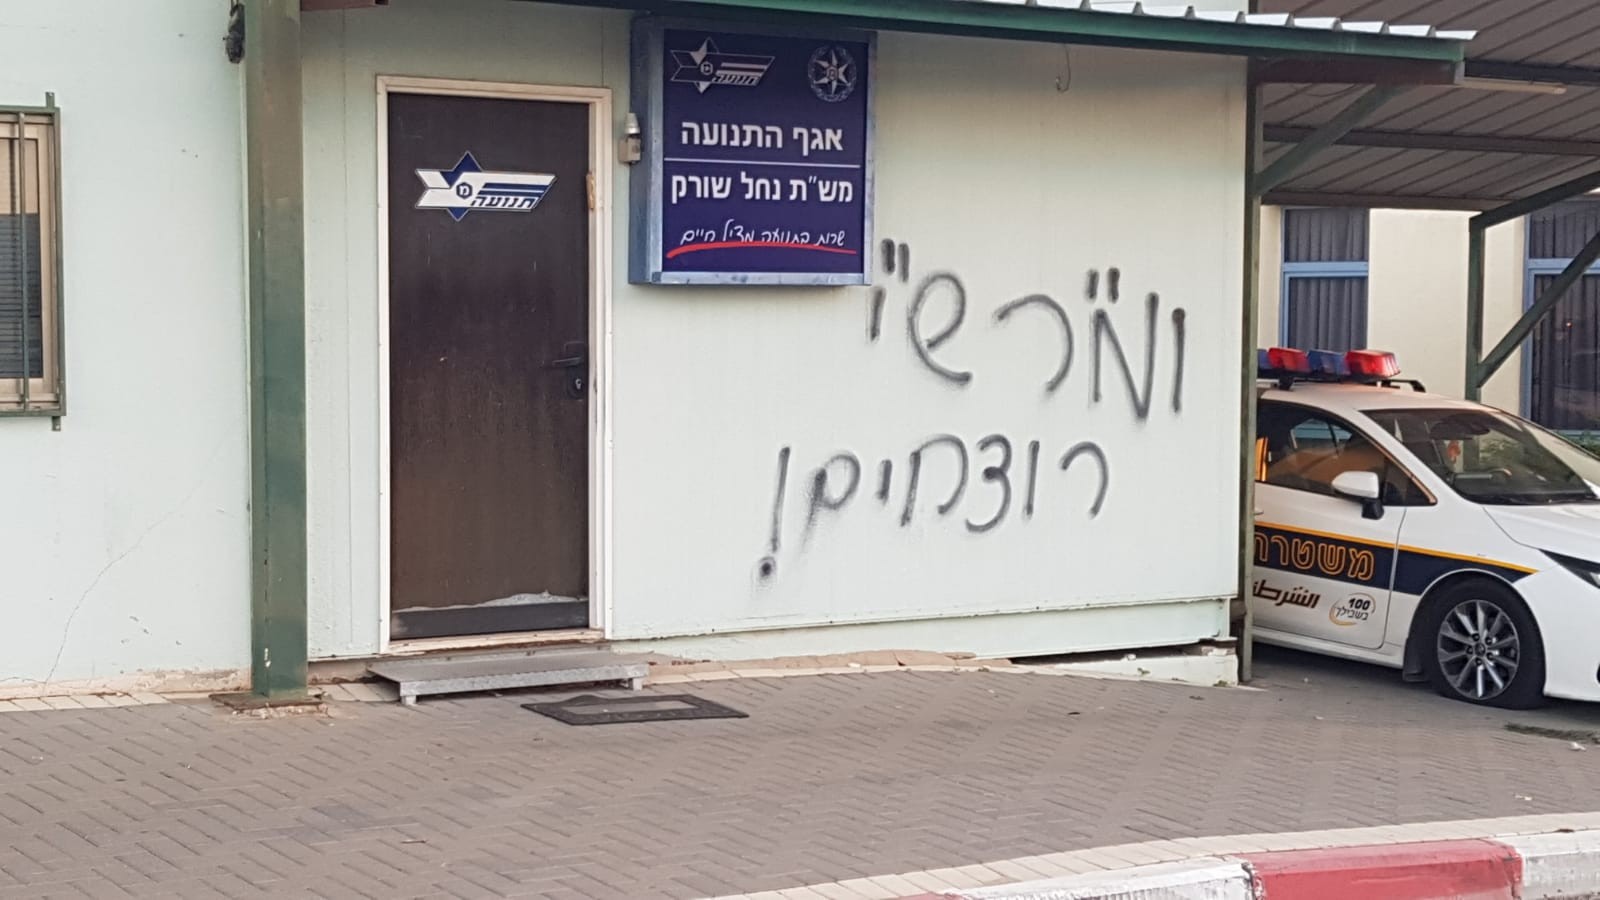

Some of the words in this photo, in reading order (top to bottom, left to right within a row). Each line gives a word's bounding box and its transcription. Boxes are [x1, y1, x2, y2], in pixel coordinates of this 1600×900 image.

[682, 121, 783, 148] התנועה
[793, 127, 843, 156] אגף
[672, 175, 732, 204] שורק
[740, 171, 781, 200] נחל
[789, 175, 853, 202] מש"ת
[470, 196, 537, 208] תנועה
[680, 229, 716, 245] חיים
[723, 219, 754, 243] מציל
[761, 228, 810, 244] בתנועה
[814, 230, 845, 246] שרות
[755, 433, 1109, 580] רוצחים!
[1335, 605, 1368, 621] בשבילך
[1349, 598, 1370, 610] 100
